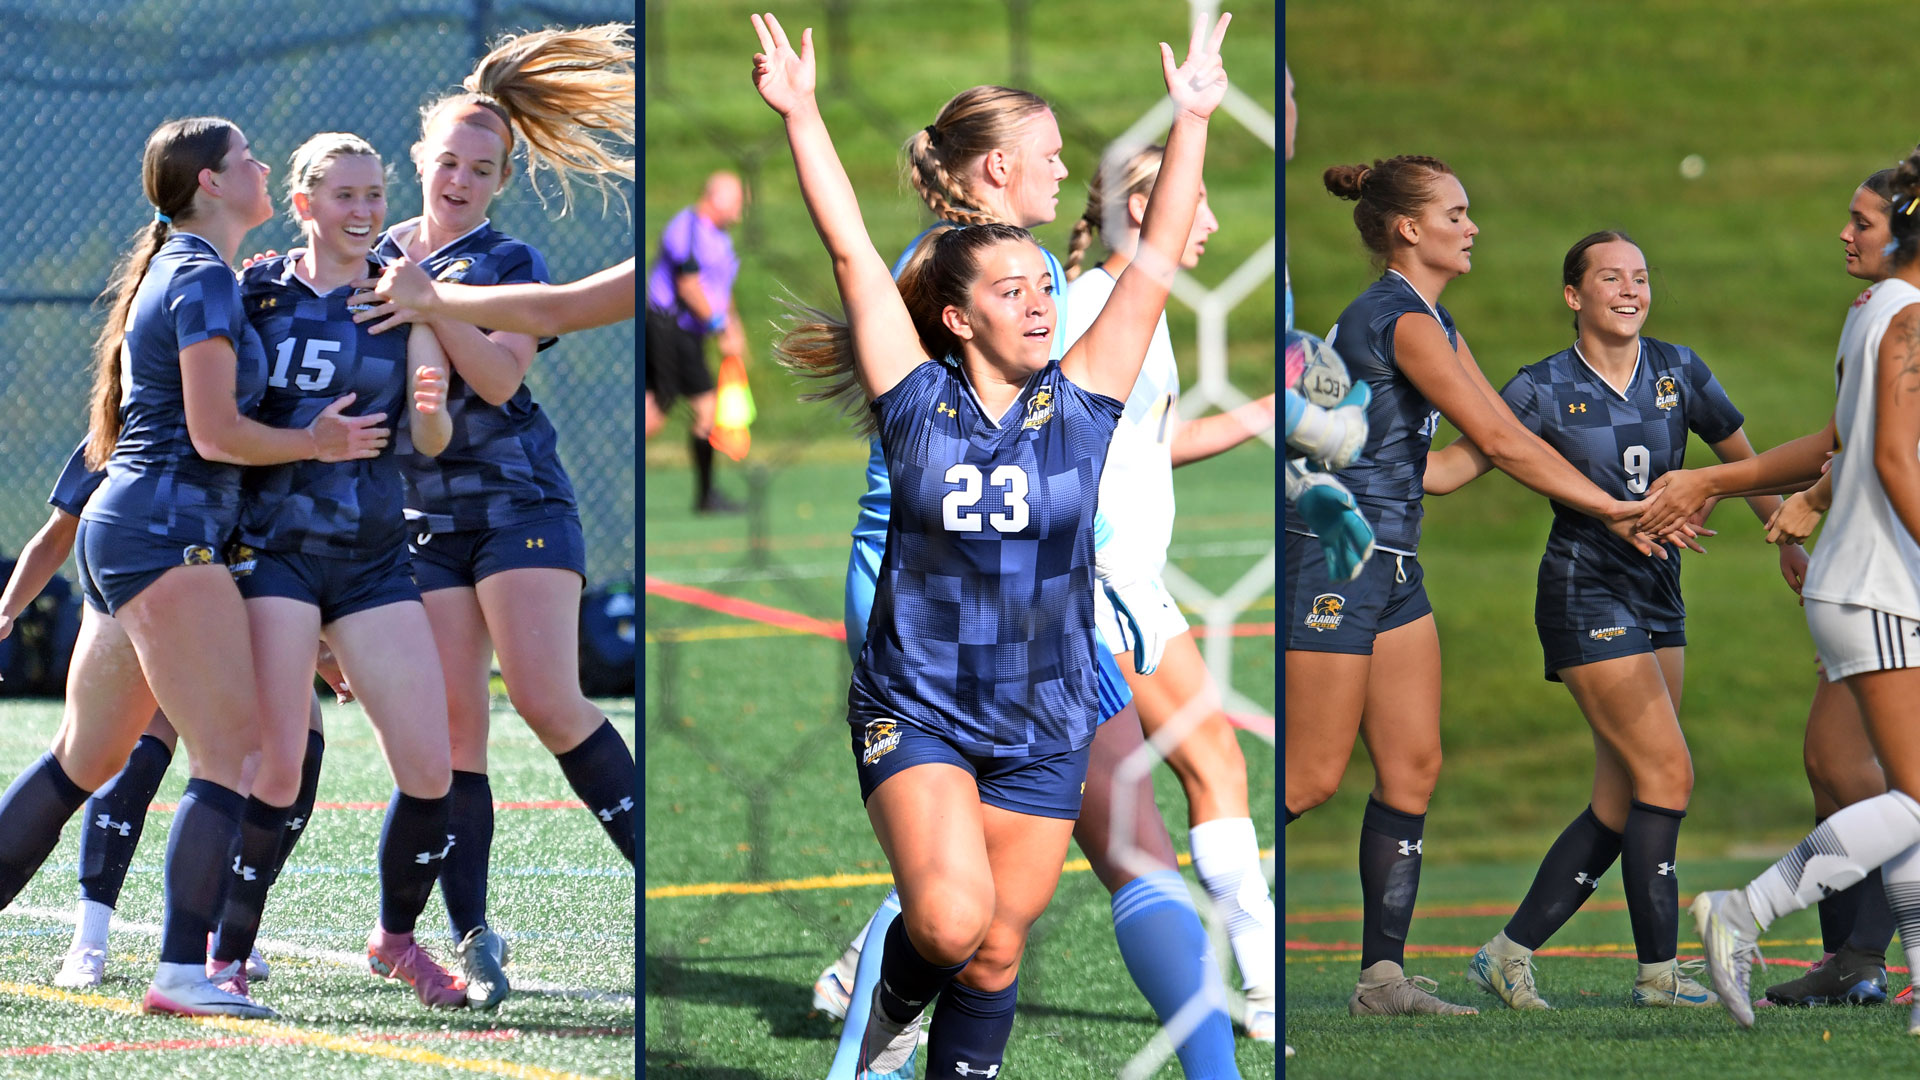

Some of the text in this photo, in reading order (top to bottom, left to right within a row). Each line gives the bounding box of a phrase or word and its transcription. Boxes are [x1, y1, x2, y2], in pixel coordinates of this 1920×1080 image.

[268, 337, 341, 391] 15
[1623, 445, 1650, 493] 9
[942, 464, 1029, 532] 23
[1305, 613, 1342, 625] CLARKE
[863, 734, 900, 763] CLARKE
